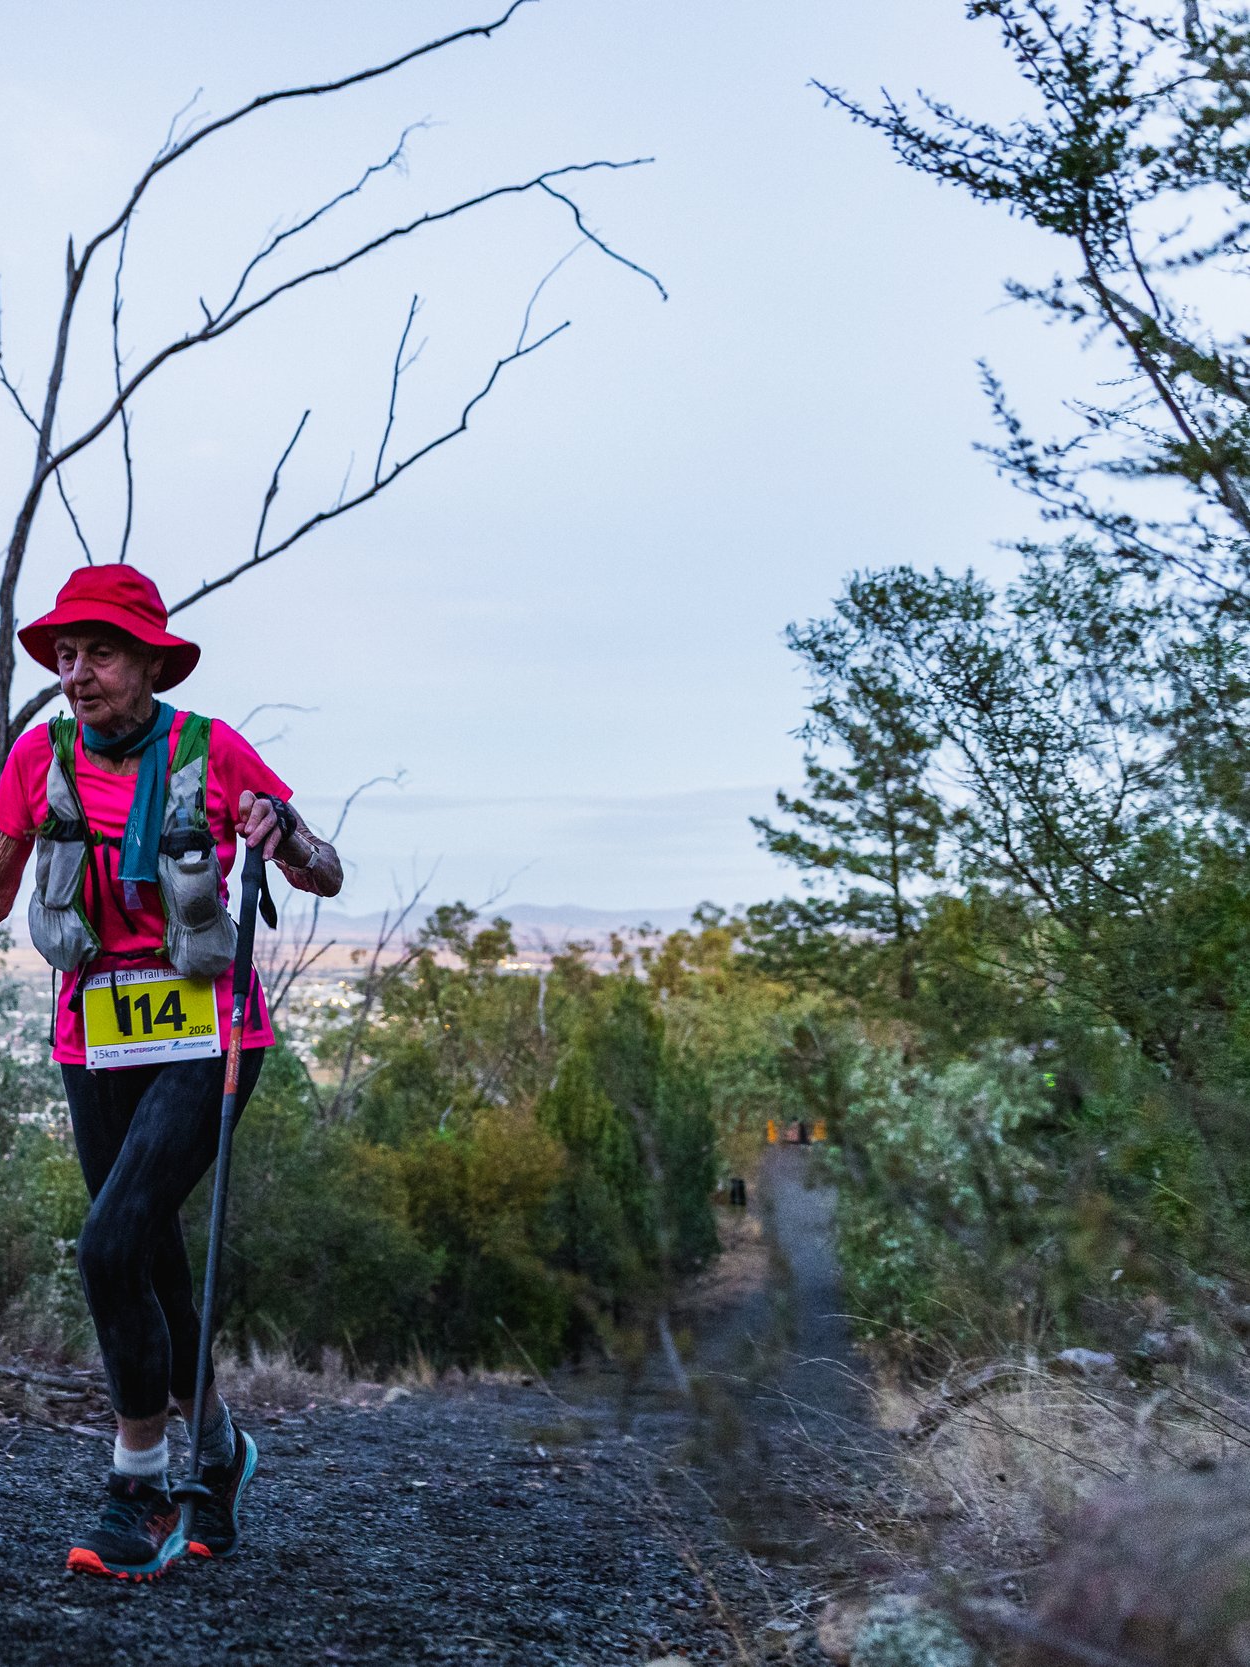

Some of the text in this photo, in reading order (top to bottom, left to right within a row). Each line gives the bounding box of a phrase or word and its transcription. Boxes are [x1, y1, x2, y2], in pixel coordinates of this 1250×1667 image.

[139, 969, 160, 979] Trail
[163, 968, 183, 977] Bla
[118, 990, 187, 1036] 114
[189, 1025, 213, 1035] 2026
[93, 1049, 120, 1059] 15km
[129, 1045, 166, 1054] INTERSPORT
